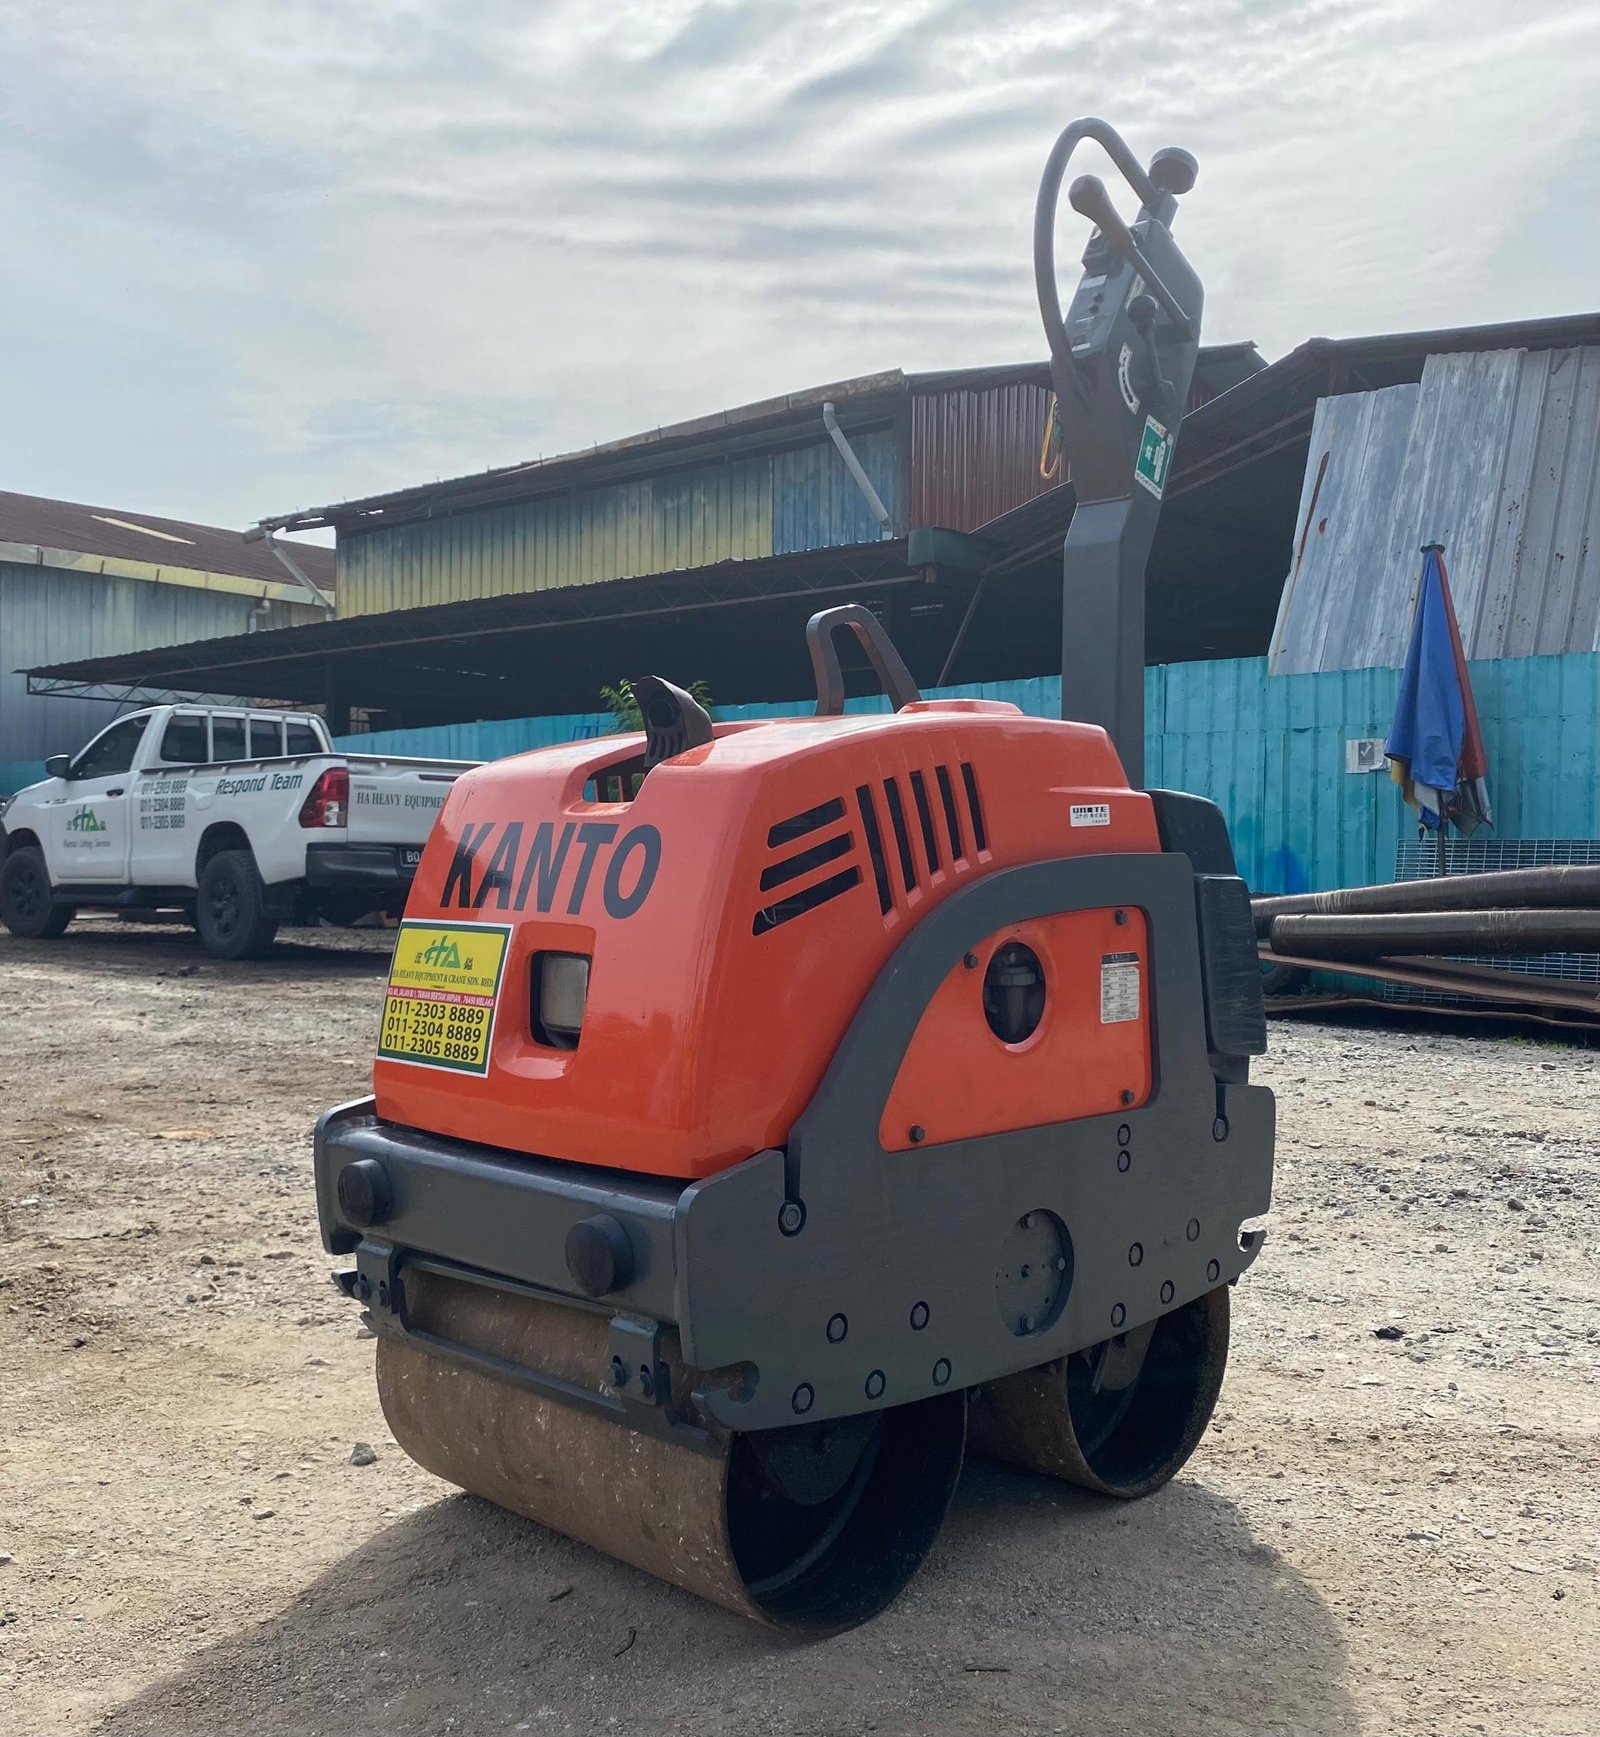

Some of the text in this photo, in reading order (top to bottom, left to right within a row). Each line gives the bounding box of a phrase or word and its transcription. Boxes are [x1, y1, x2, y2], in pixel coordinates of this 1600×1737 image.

[141, 781, 171, 795] 011-2303
[215, 773, 303, 796] Respond Team
[140, 798, 169, 812] 011-2304
[357, 792, 370, 805] HA
[372, 792, 402, 806] HEAVY
[140, 815, 170, 829] 011-2305
[439, 821, 662, 920] KANTO
[415, 971, 444, 982] EQUIPMENT
[448, 974, 466, 985] CRANE
[390, 999, 485, 1025] 011-2303 8889
[387, 1016, 482, 1043] 011-2304 8889
[385, 1033, 479, 1062] 011-2305 8889
